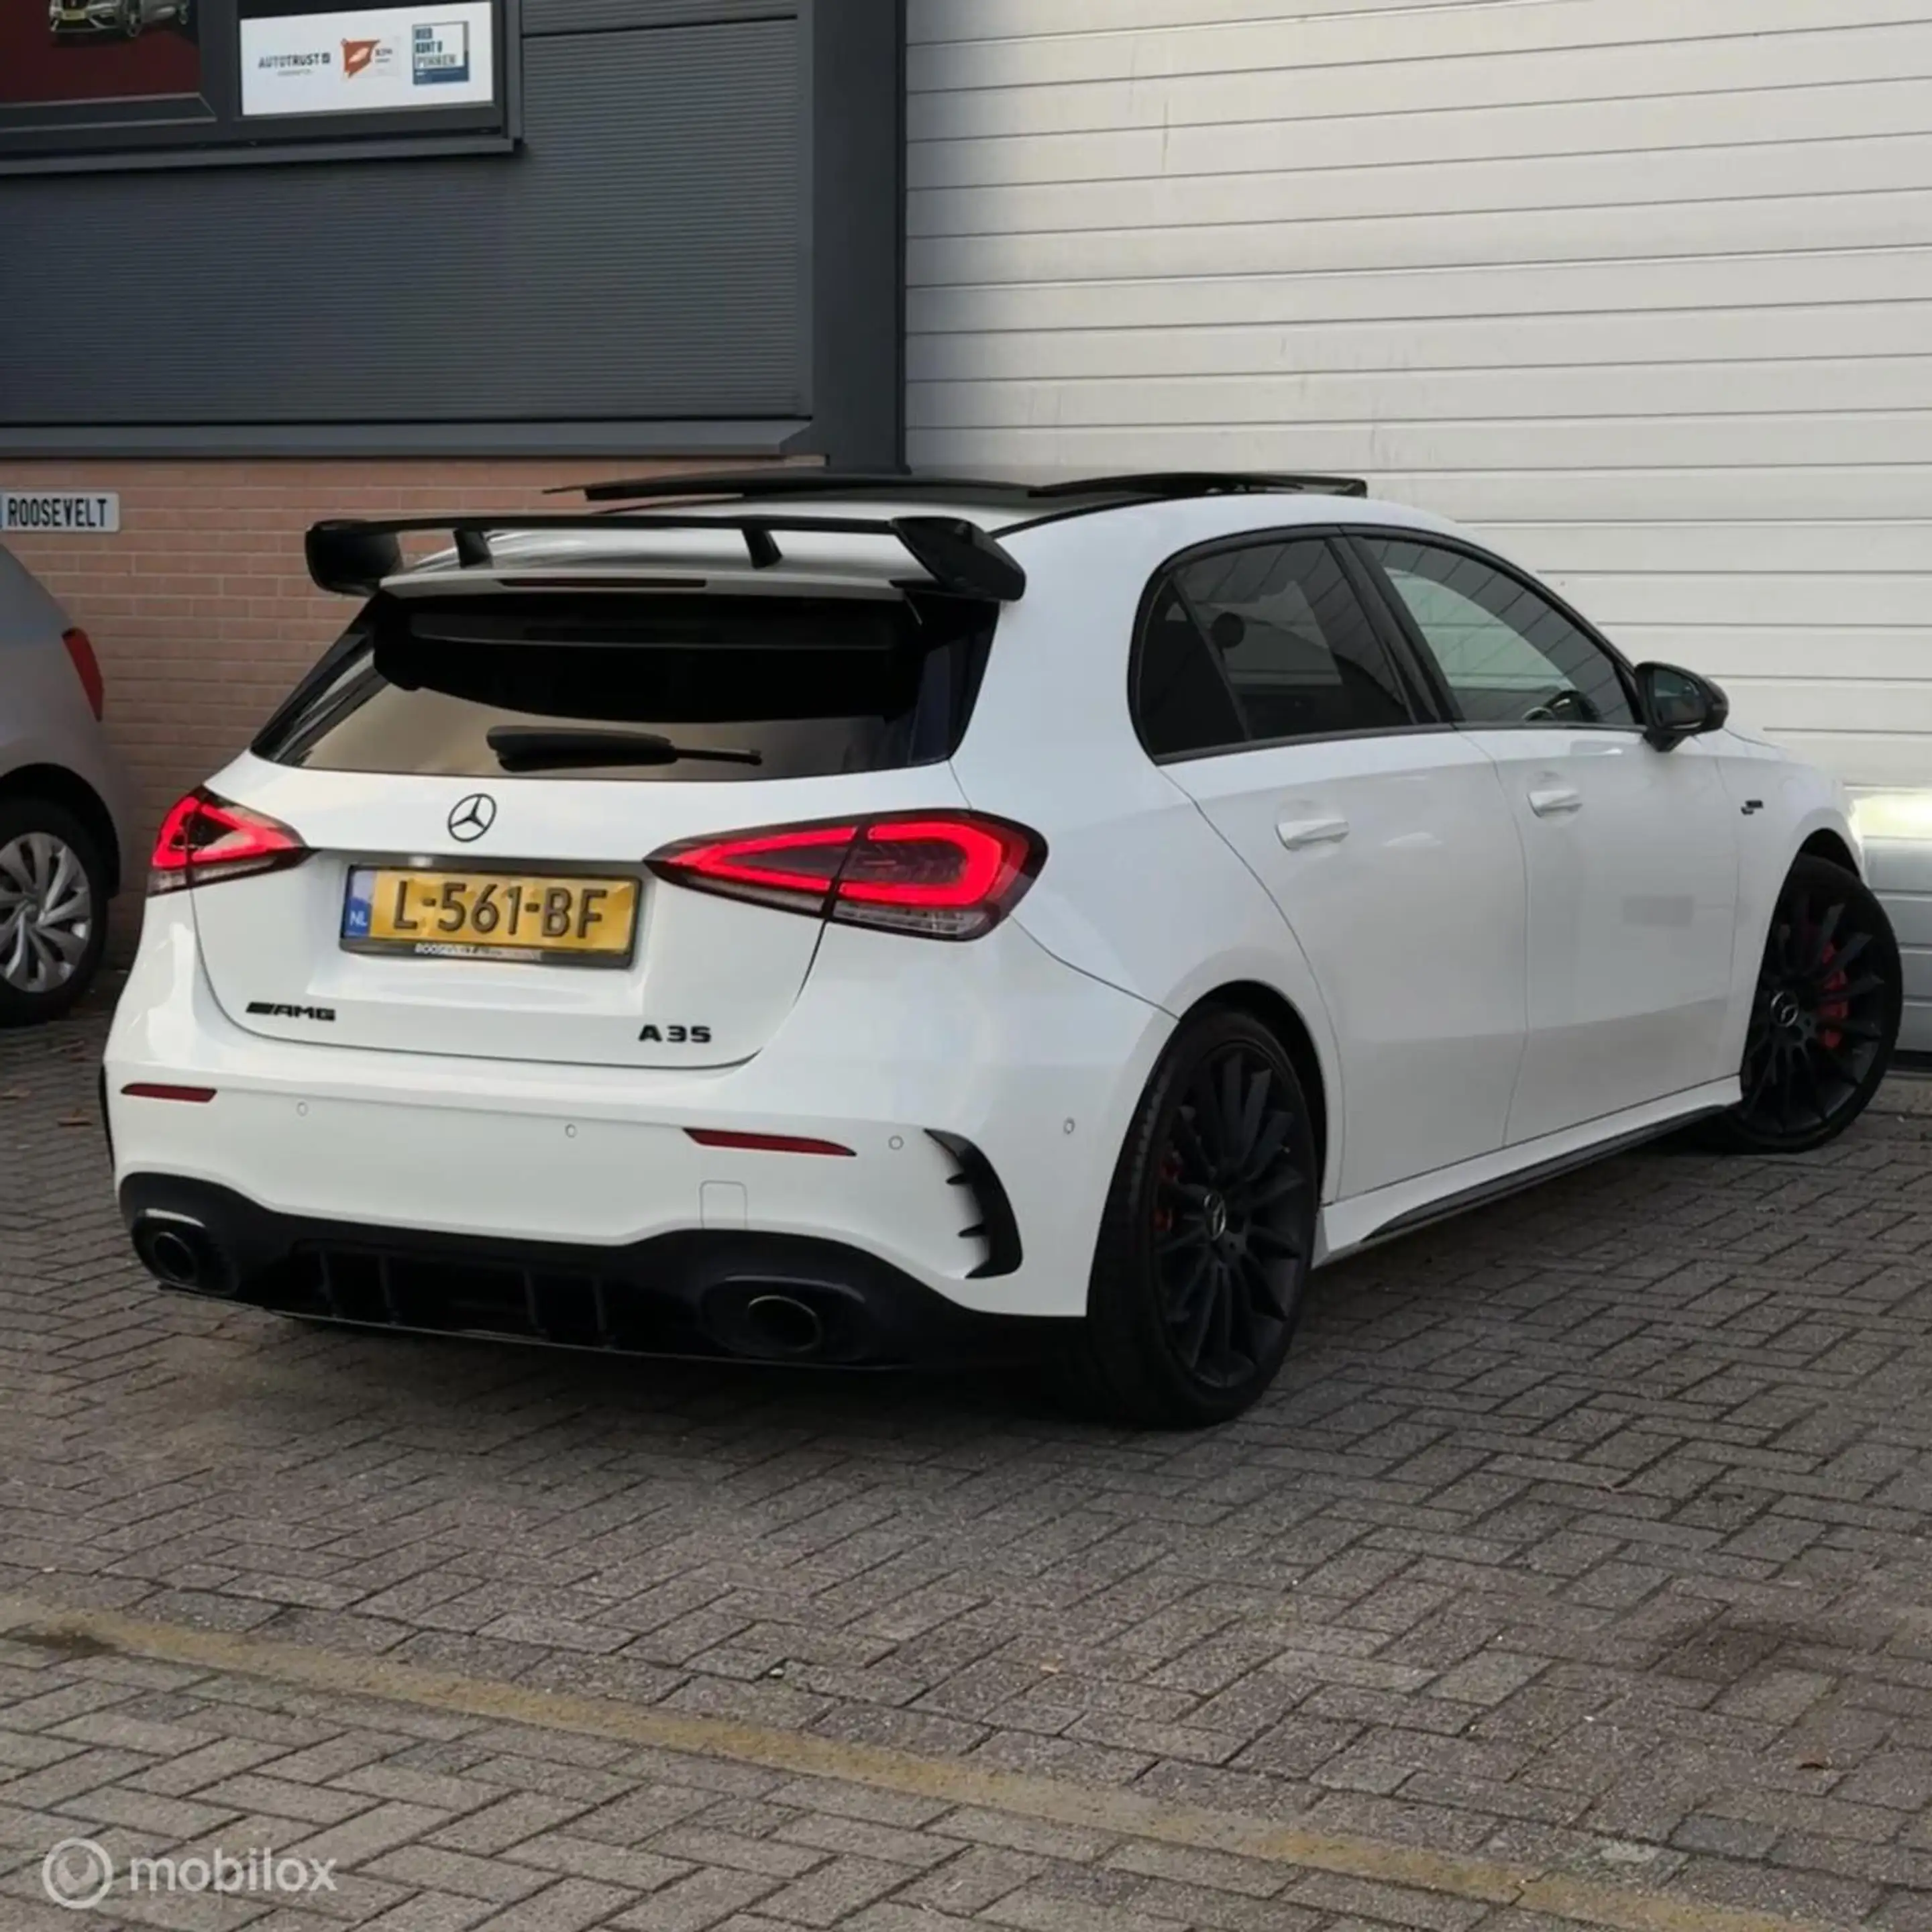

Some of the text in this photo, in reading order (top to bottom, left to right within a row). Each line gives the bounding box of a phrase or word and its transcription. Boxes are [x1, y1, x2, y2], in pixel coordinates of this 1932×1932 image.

[258, 53, 320, 68] AUTOTRUST
[8, 498, 107, 527] ROOSEVELT
[392, 879, 608, 938] L-561-BF
[350, 909, 368, 927] NL
[271, 1004, 335, 1021] AMG
